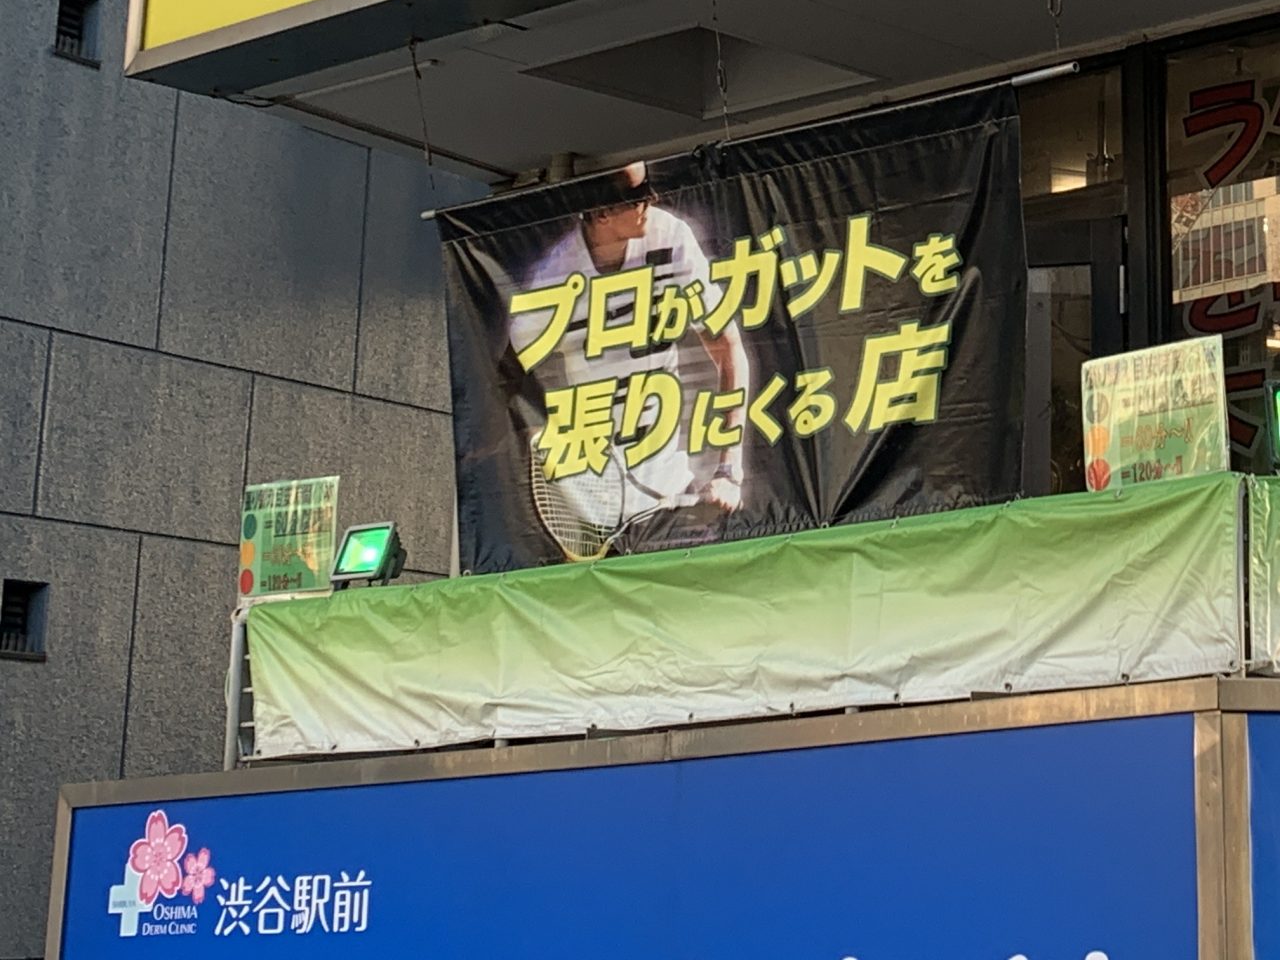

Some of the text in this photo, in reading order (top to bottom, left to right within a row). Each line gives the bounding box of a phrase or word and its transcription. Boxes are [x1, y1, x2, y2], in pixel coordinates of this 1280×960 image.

[508, 212, 962, 373] プロがガットを
[536, 319, 952, 480] 張りにくる店
[153, 903, 198, 921] OSHIMA
[214, 870, 373, 936] 渋谷駅前
